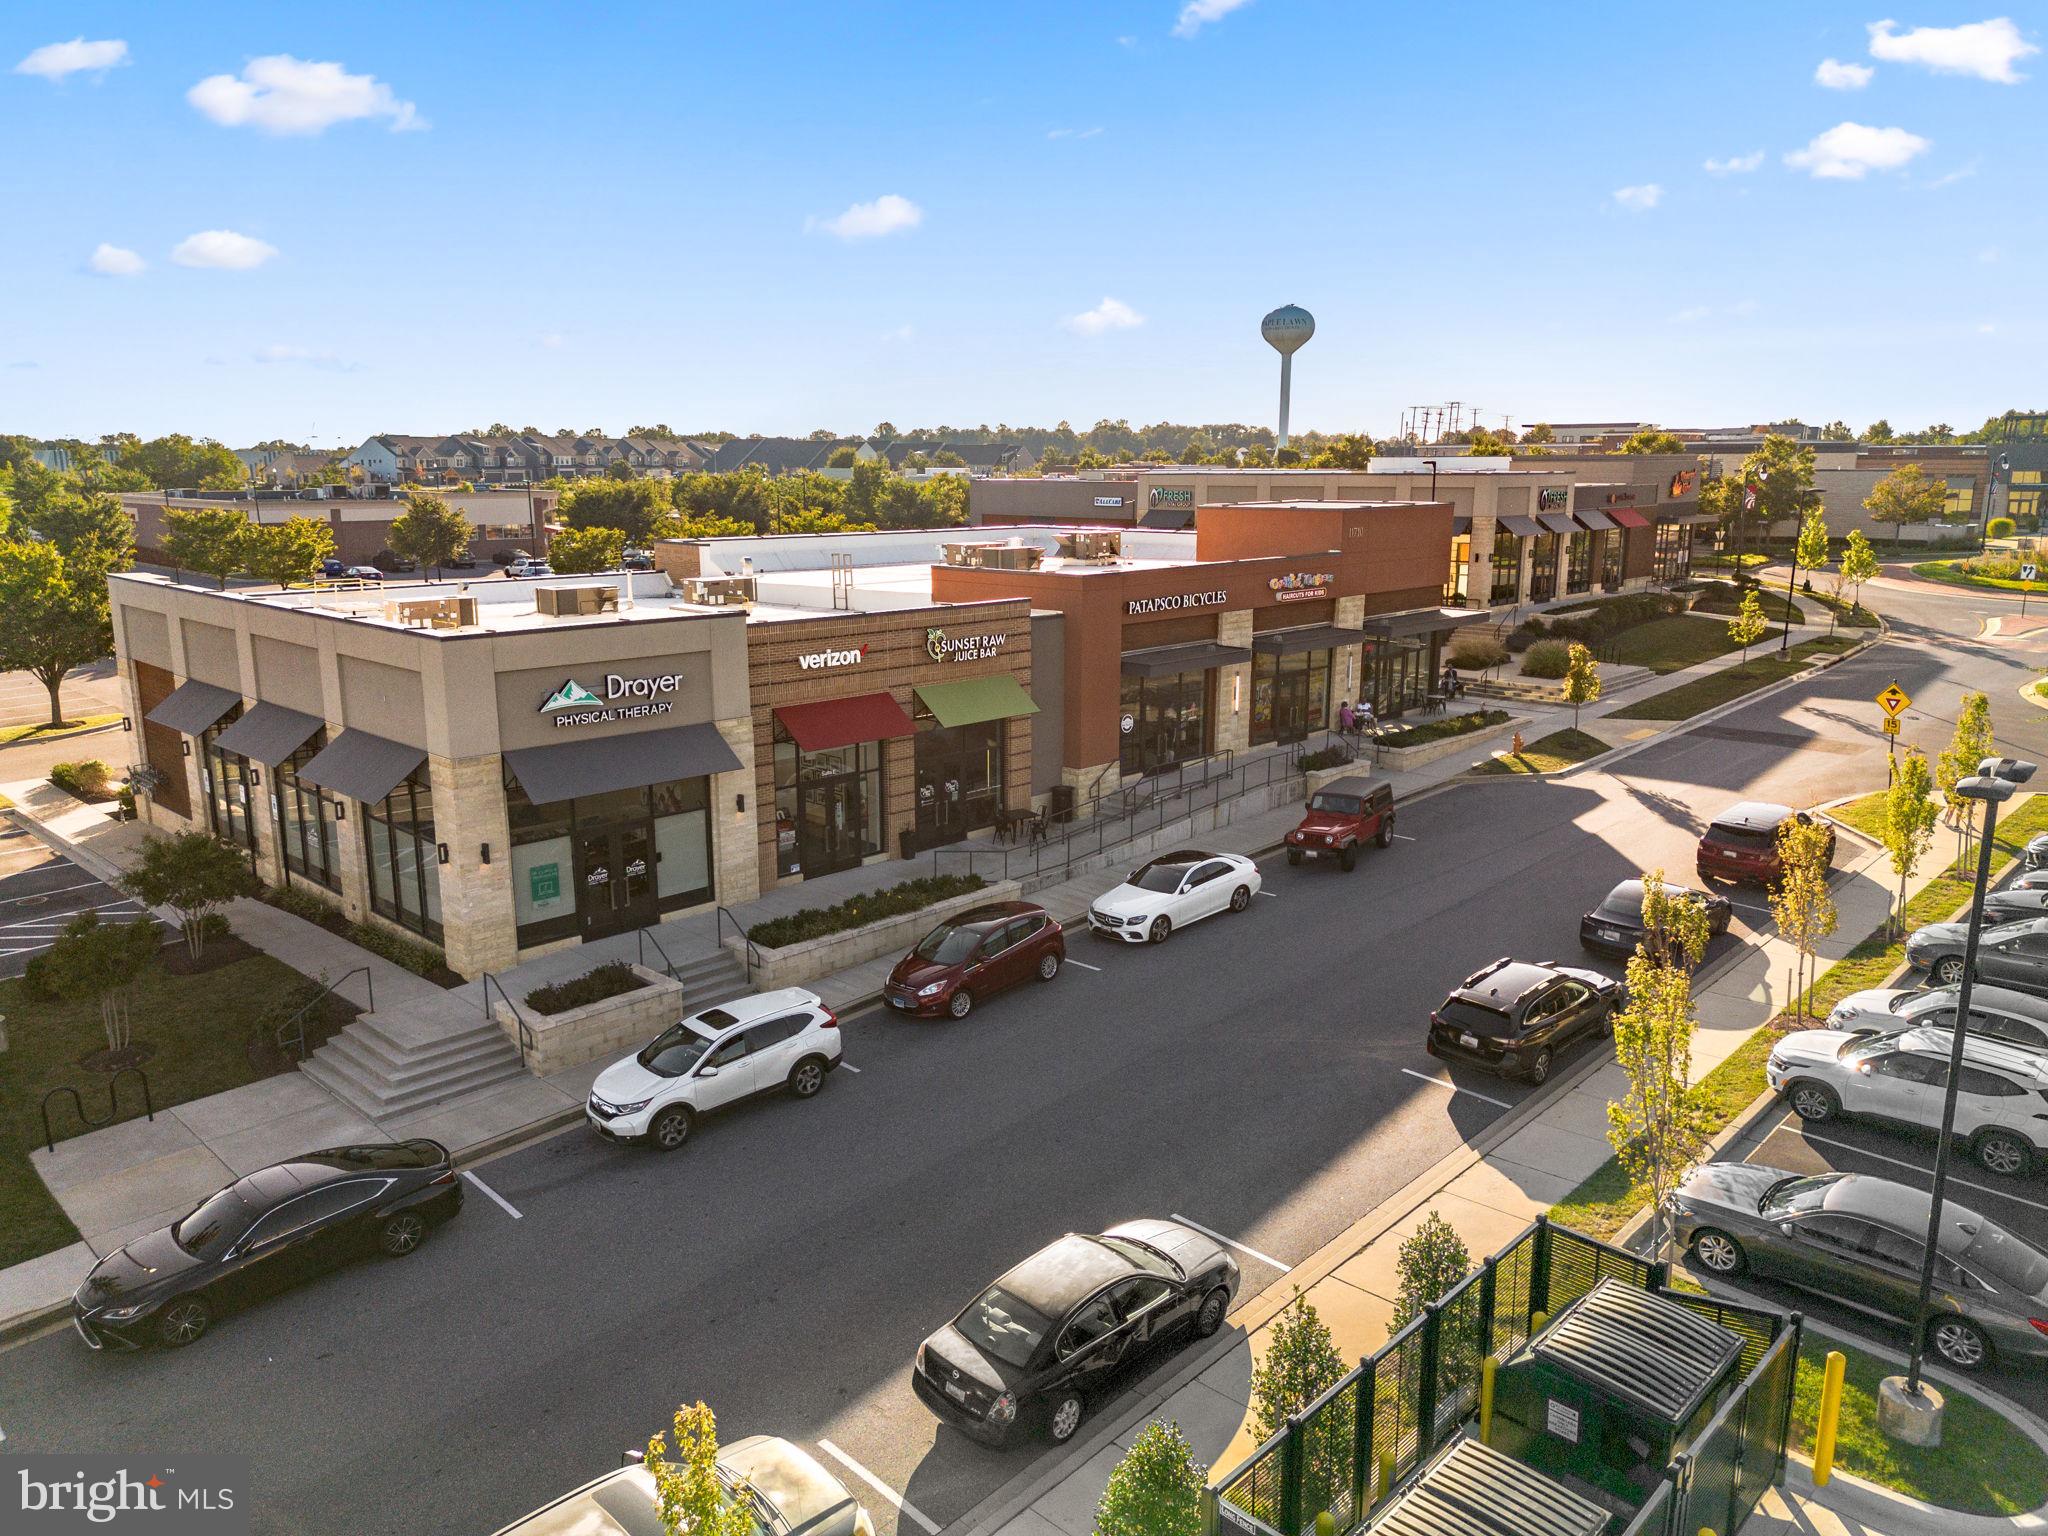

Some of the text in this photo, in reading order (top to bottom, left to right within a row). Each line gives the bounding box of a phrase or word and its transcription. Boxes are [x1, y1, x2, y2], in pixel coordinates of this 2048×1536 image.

[1163, 490, 1191, 501] FRESH
[1129, 590, 1227, 615] PATAPSCO BICYCLES
[1282, 592, 1304, 600] HAIRCUTS
[941, 634, 1006, 652] SUNSET RAW
[799, 648, 861, 670] verizon
[953, 647, 997, 662] JUICE BAR
[606, 674, 683, 700] Drayer
[556, 702, 673, 728] PHYSICAL THERAPY
[1886, 719, 1898, 729] 15
[1221, 1503, 1255, 1533] LONG FENCE
